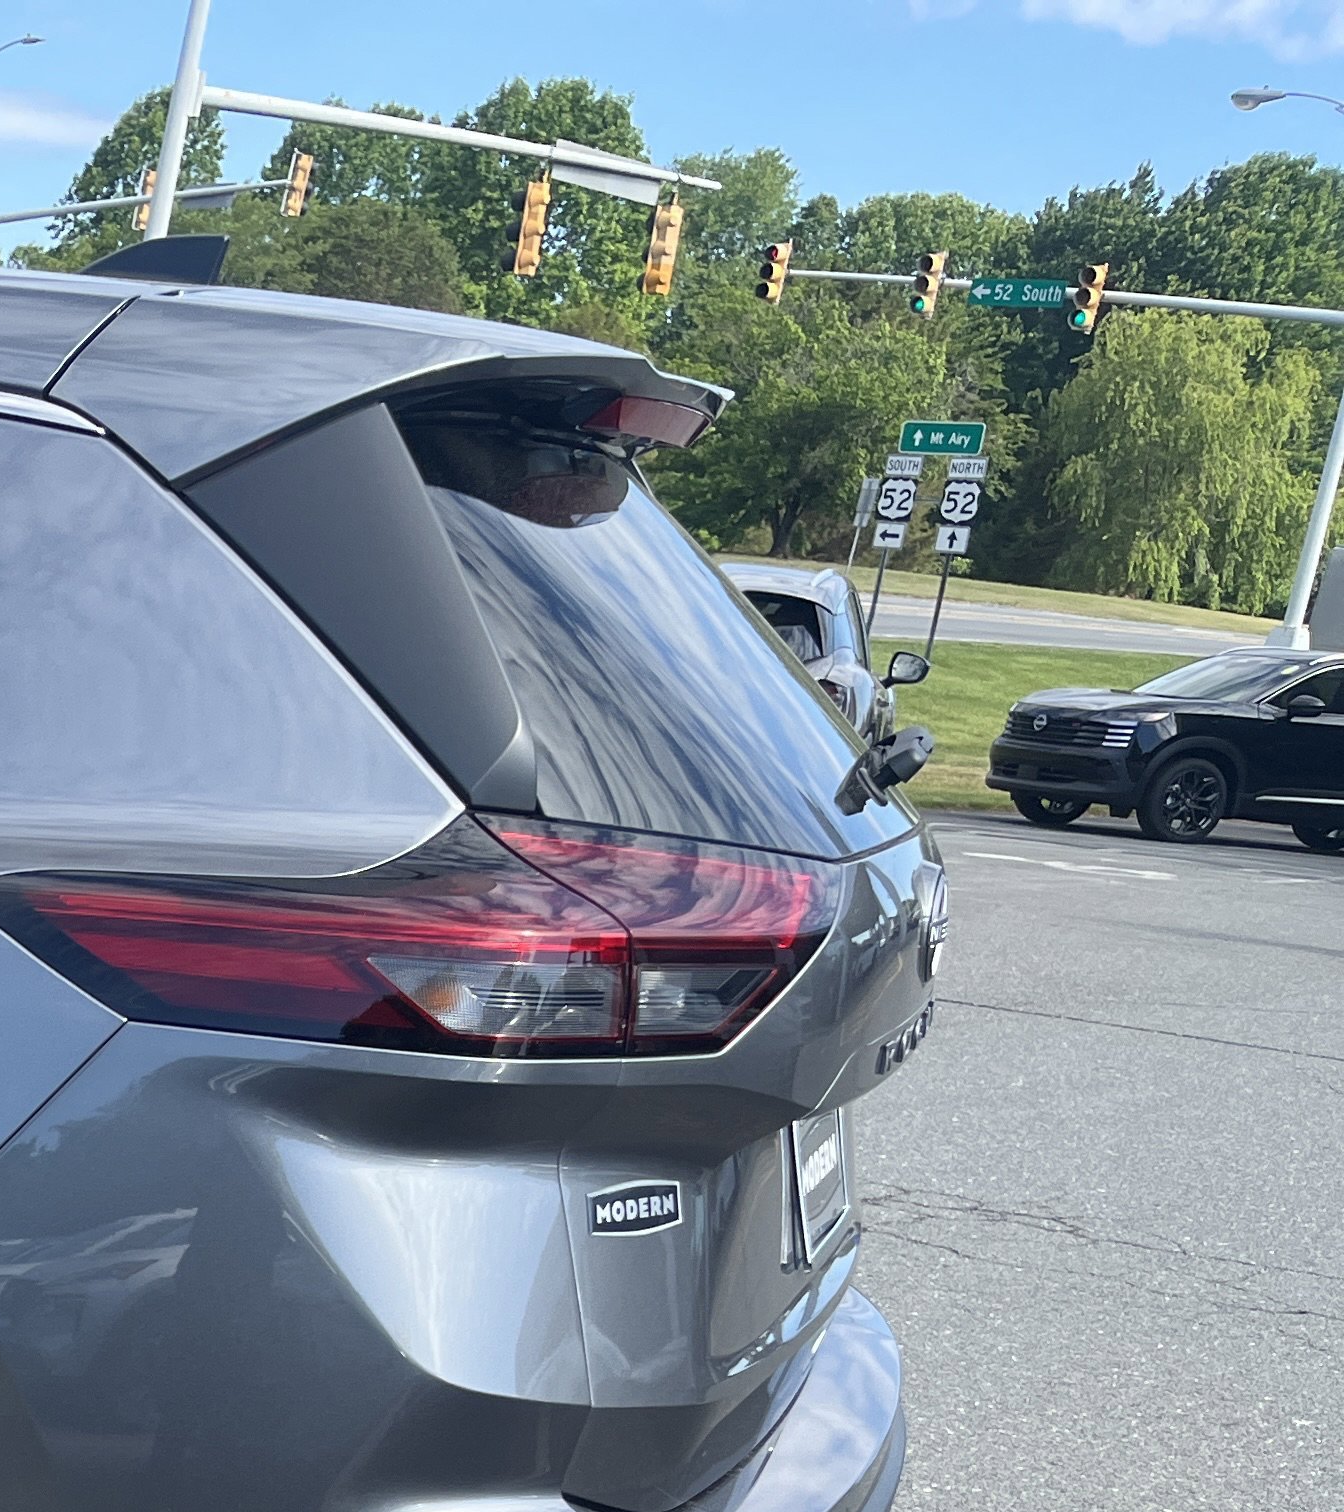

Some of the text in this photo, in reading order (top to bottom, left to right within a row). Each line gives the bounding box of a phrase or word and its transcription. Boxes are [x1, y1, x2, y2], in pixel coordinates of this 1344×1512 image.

[994, 283, 1062, 302] 52 South
[930, 431, 971, 449] Mt Airy
[887, 460, 920, 471] SOUTH
[951, 462, 984, 474] NORTH
[881, 488, 912, 511] 52
[944, 491, 976, 514] 52
[596, 1193, 675, 1224] MODERN
